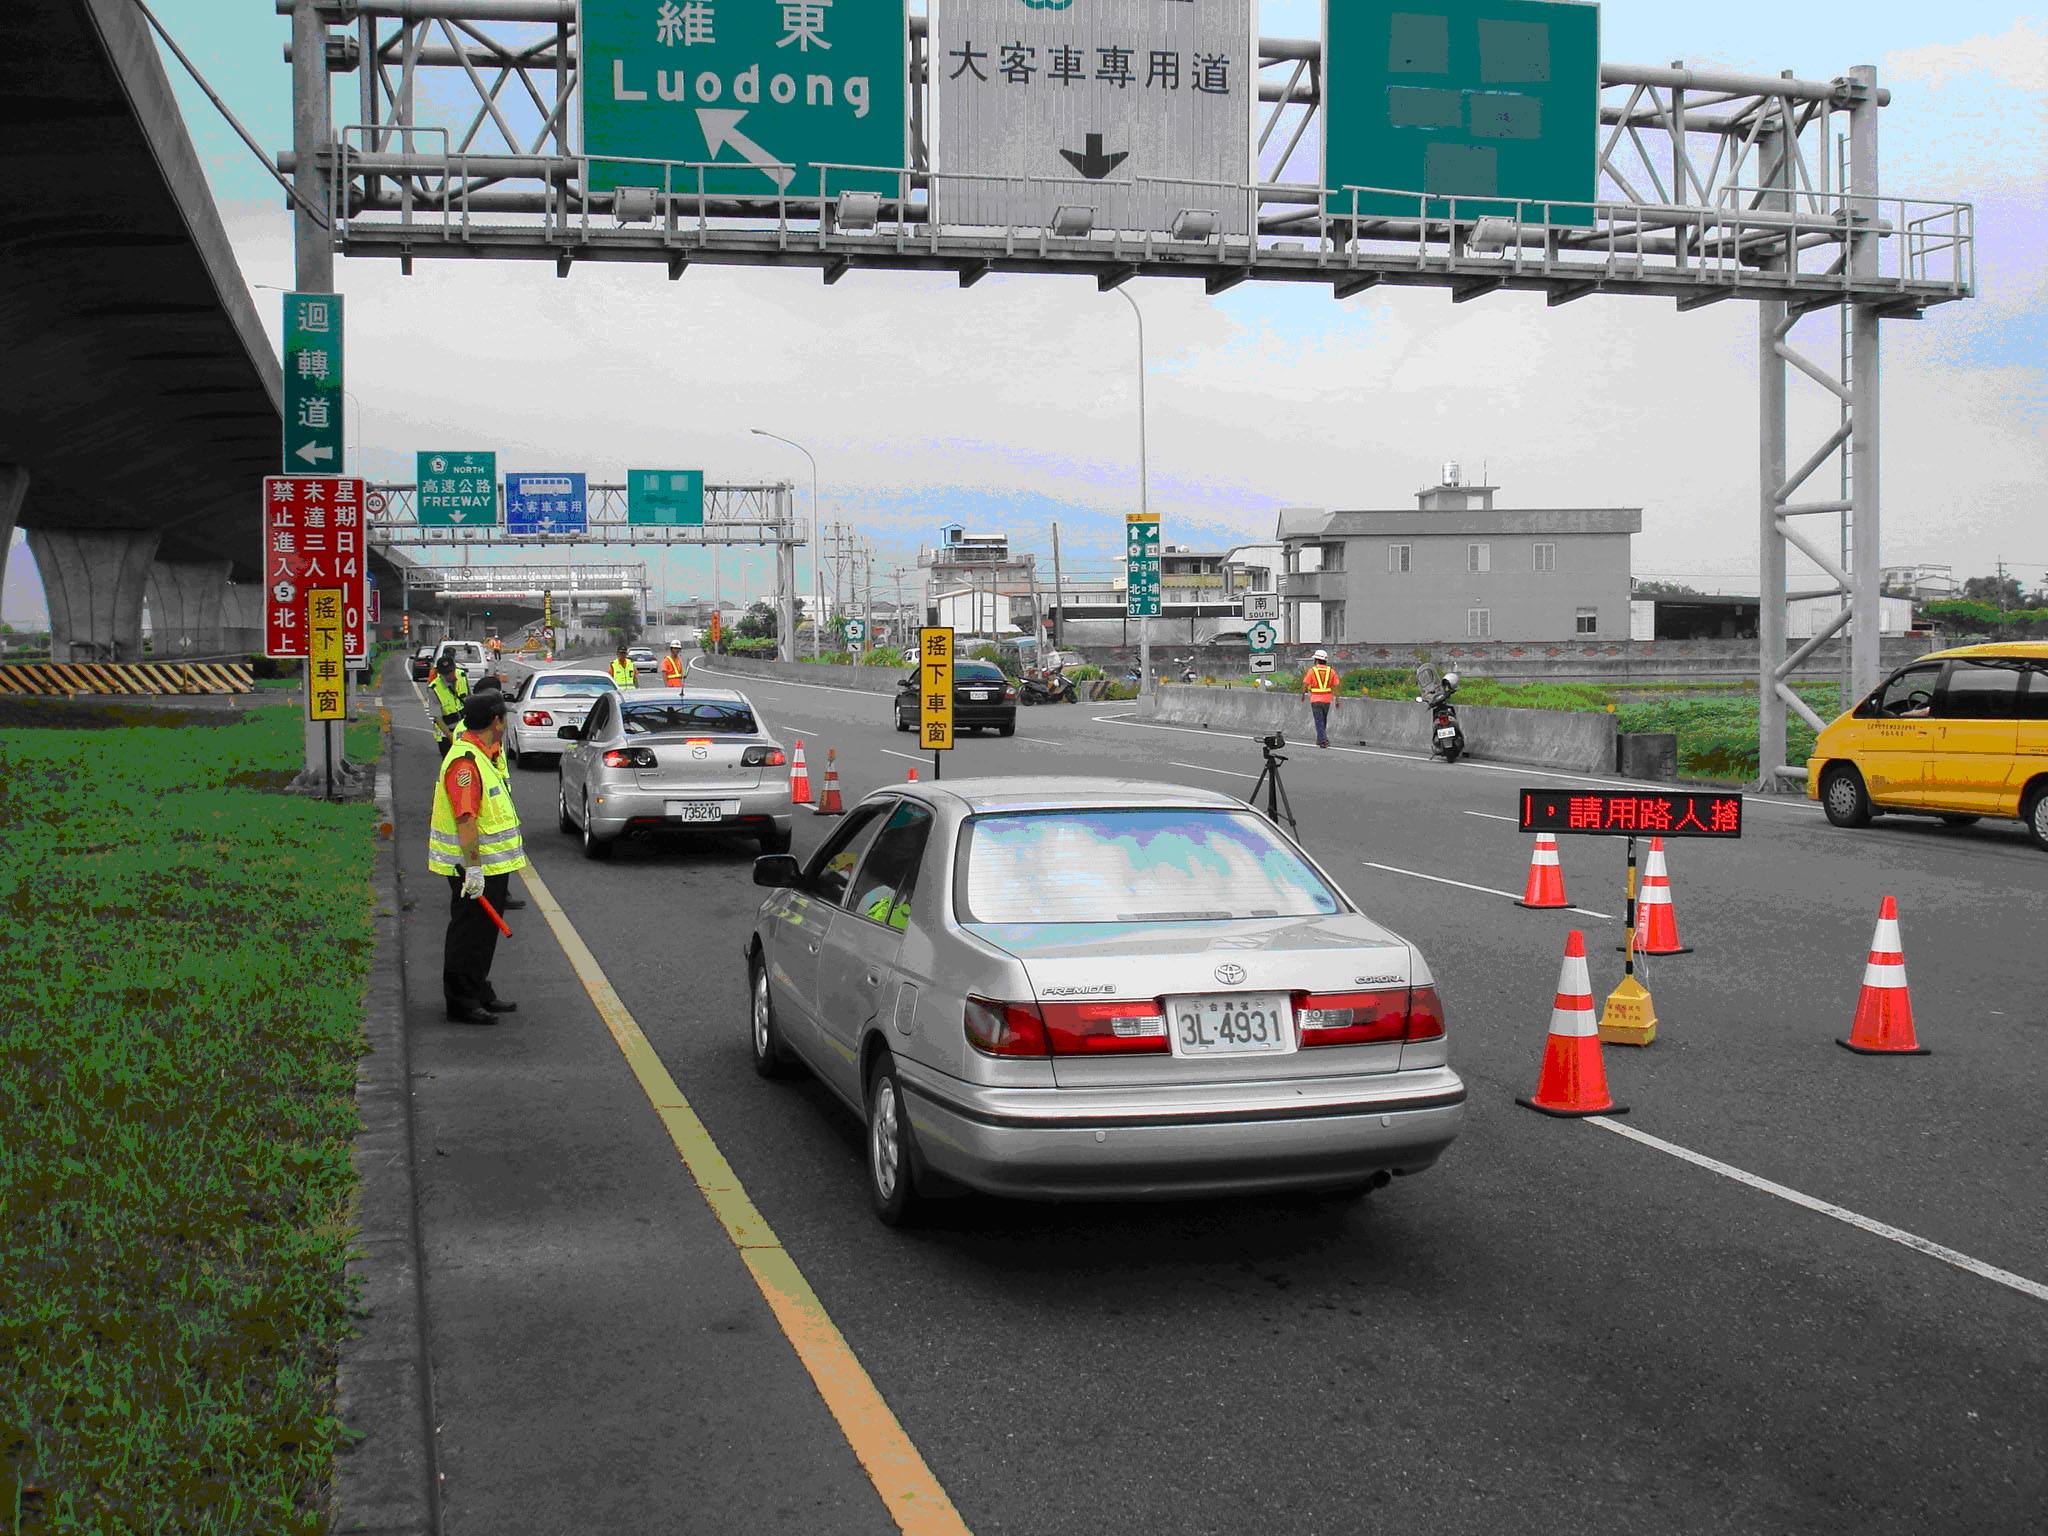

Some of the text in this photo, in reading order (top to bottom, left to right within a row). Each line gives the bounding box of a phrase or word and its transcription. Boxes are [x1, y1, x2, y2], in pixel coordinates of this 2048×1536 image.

[949, 41, 1230, 94] 大客車專用道
[613, 59, 870, 119] Luodong
[297, 302, 330, 428] 迴轉道
[422, 479, 491, 493] 高速公路
[422, 496, 491, 507] FREEWAY
[511, 500, 582, 513] 大客車專用
[1129, 603, 1141, 614] 37
[1150, 603, 1157, 614] 9
[1255, 597, 1267, 609] 南
[851, 626, 858, 635] 5
[1257, 632, 1267, 643] 5
